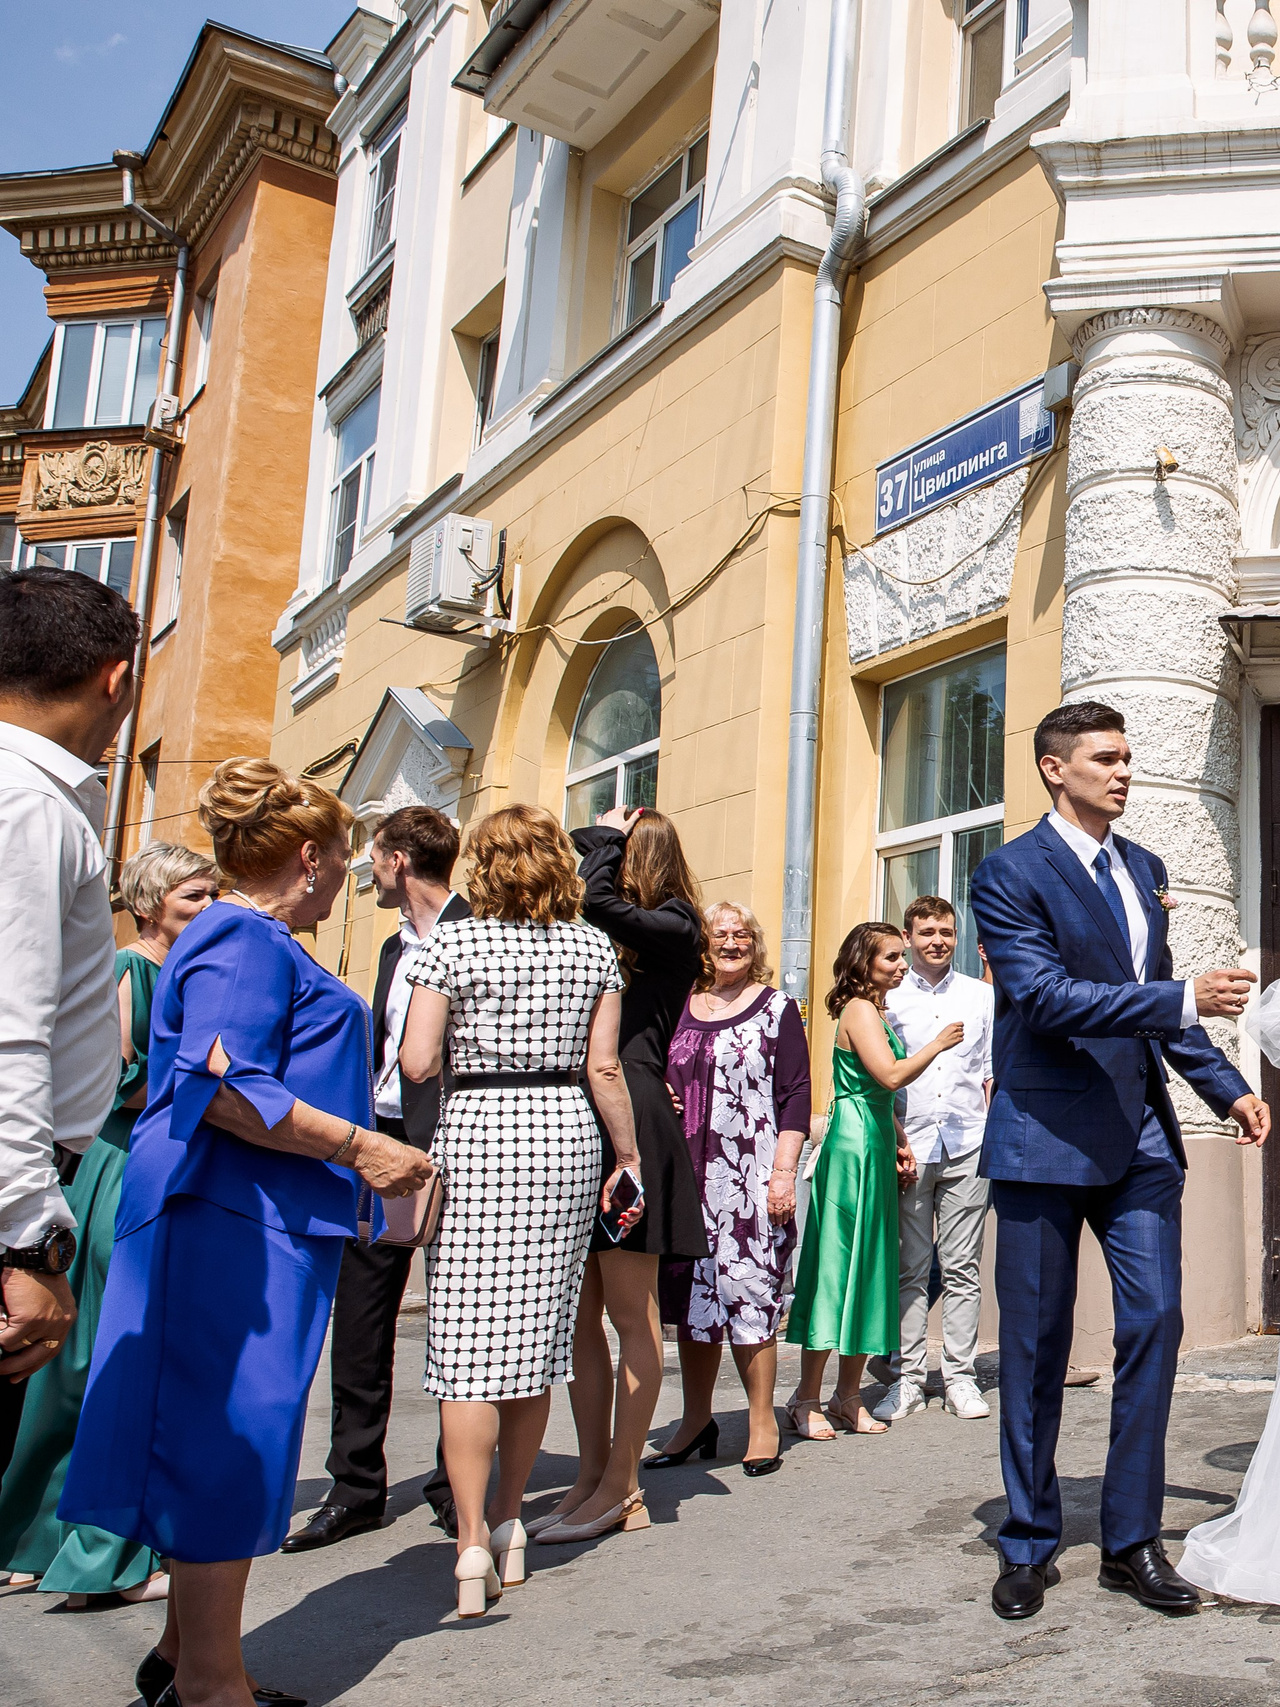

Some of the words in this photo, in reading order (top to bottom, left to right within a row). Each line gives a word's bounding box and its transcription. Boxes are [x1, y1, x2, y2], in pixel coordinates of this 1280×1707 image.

[913, 449, 946, 478] улица
[914, 440, 1008, 503] Цвиллинга
[880, 469, 909, 519] 37
